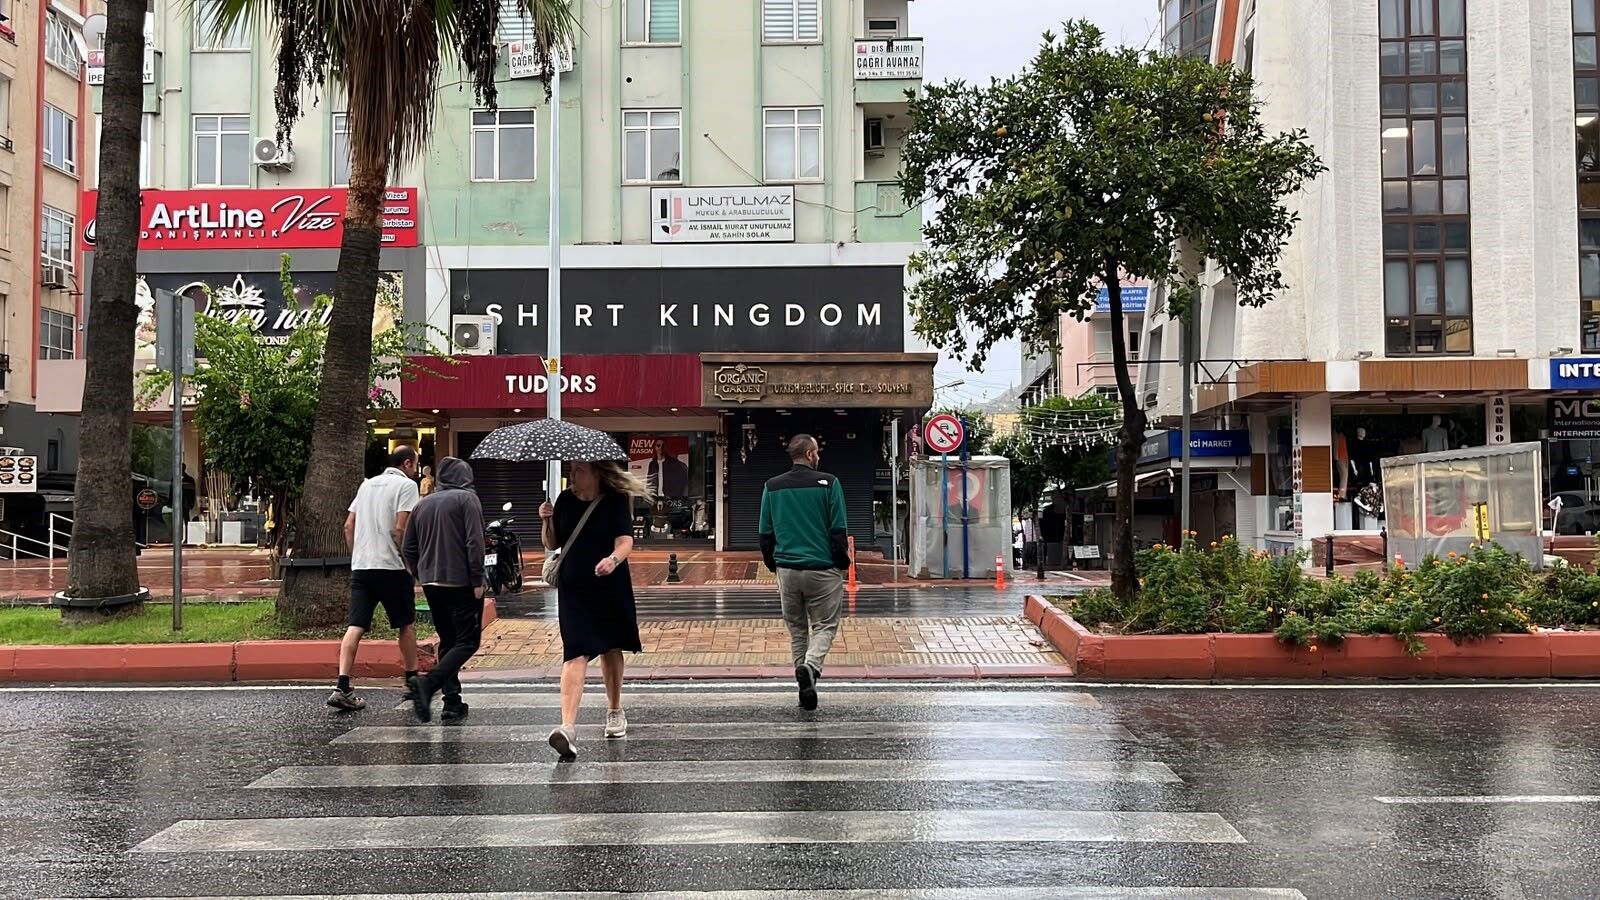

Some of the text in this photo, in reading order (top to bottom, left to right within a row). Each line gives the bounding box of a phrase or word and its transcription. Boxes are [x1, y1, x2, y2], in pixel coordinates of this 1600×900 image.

[88, 72, 105, 83] İPE
[688, 194, 791, 206] UNUTULMAZ
[148, 195, 341, 233] ArtLine Vize
[728, 208, 784, 216] ARABULUCULUK
[749, 222, 792, 230] UNUTULMAZ
[141, 230, 281, 241] DANIŞMANLIK
[485, 303, 882, 327] SHRT KINGDOM
[718, 373, 765, 384] ORGANIC
[722, 384, 760, 393] GARDEN
[1493, 397, 1505, 443] MONDO
[631, 439, 655, 448] NEW
[1201, 440, 1233, 448] MARKET
